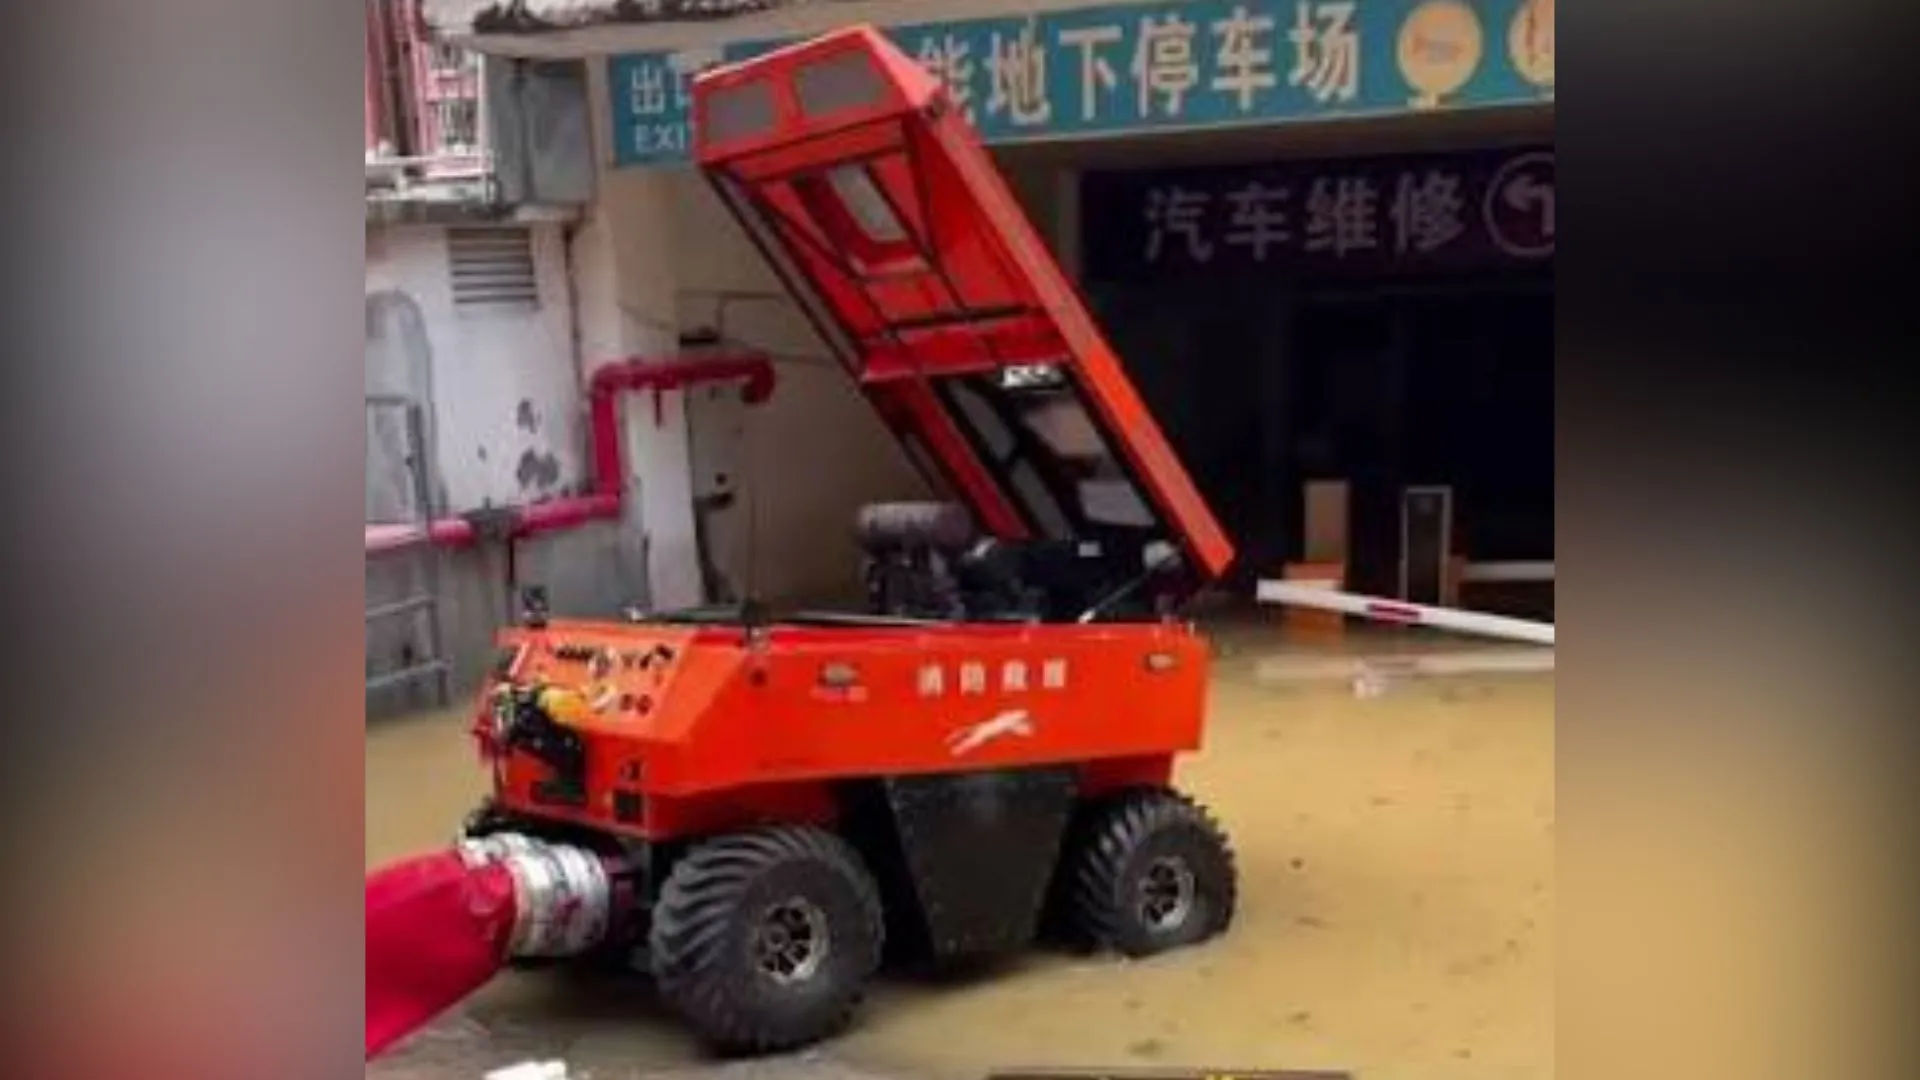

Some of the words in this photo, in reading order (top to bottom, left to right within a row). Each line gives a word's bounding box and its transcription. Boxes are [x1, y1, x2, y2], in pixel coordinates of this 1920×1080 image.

[635, 121, 695, 153] EXI
[1143, 171, 1467, 262] 汽车维修
